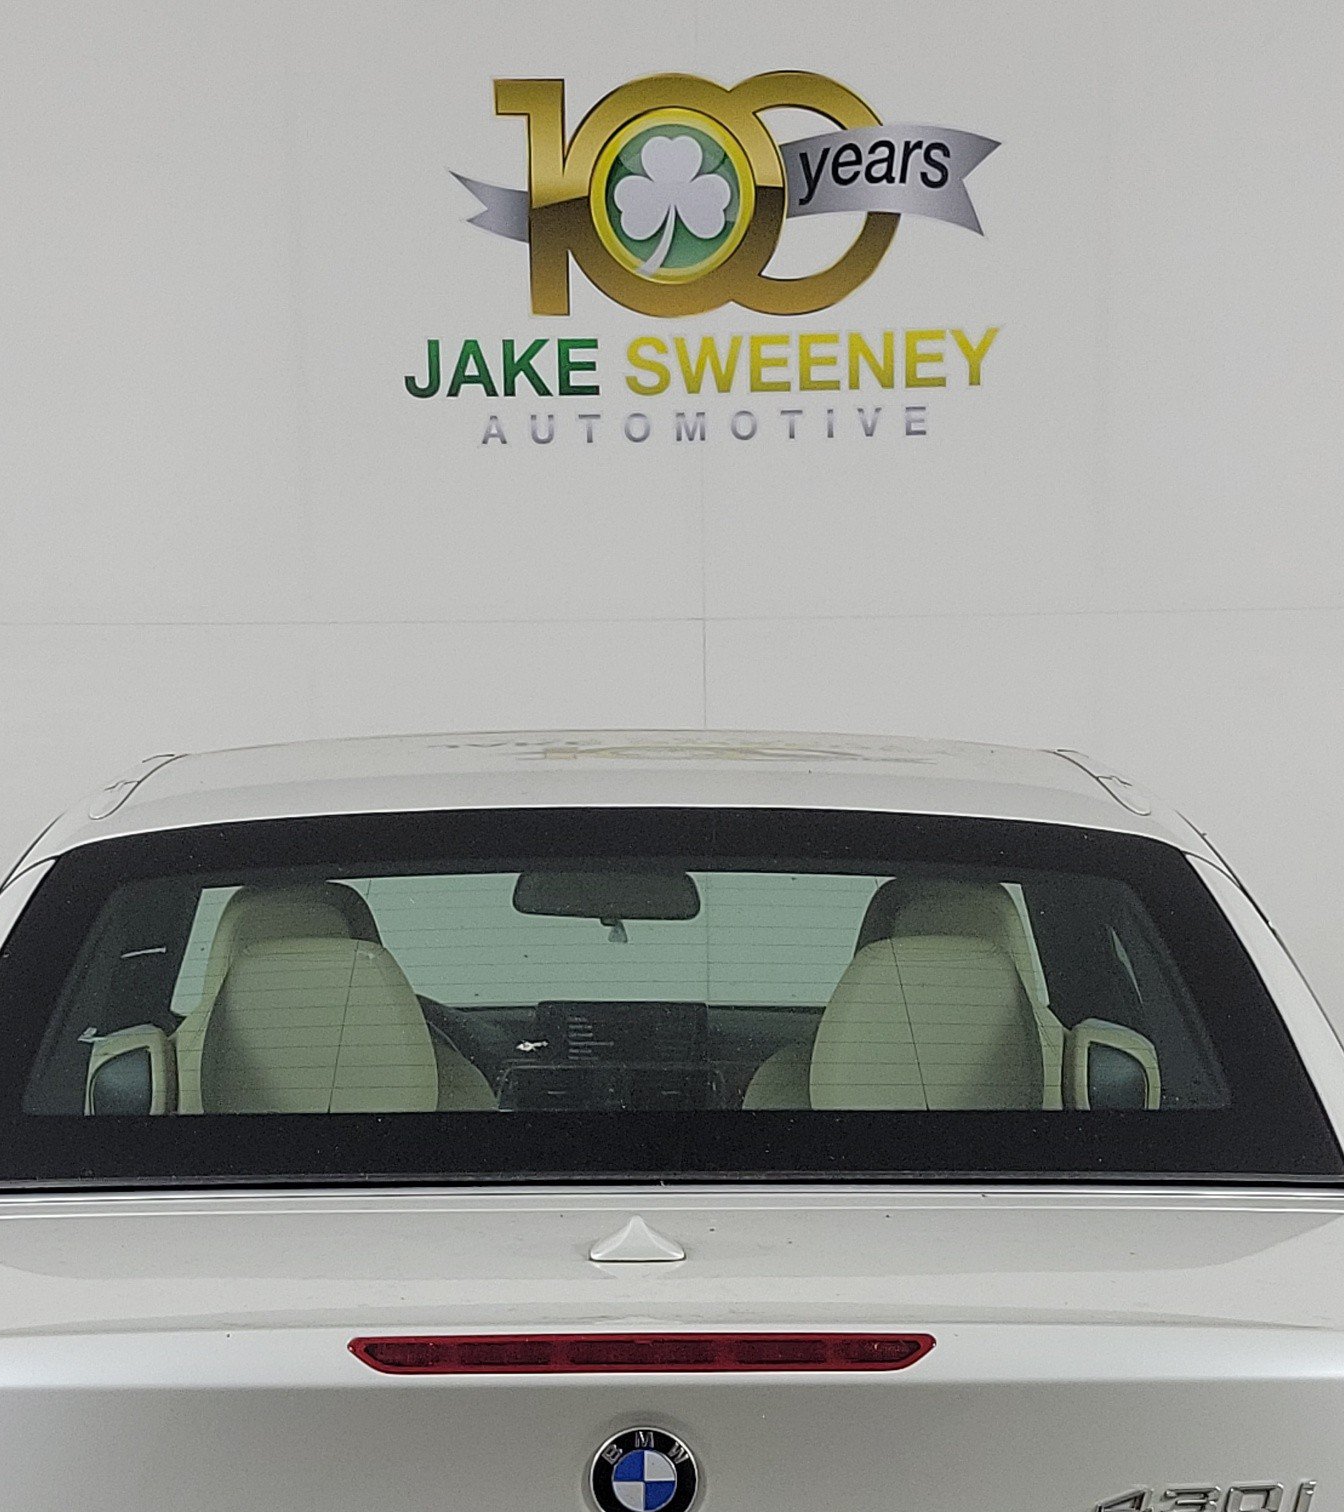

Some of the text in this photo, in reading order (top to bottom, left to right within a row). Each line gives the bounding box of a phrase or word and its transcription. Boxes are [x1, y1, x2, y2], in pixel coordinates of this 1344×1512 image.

[798, 138, 951, 206] years
[404, 328, 998, 399] JAKE SWEENEY
[481, 406, 928, 446] AUTOMOTIVE
[602, 1431, 689, 1465] BMW
